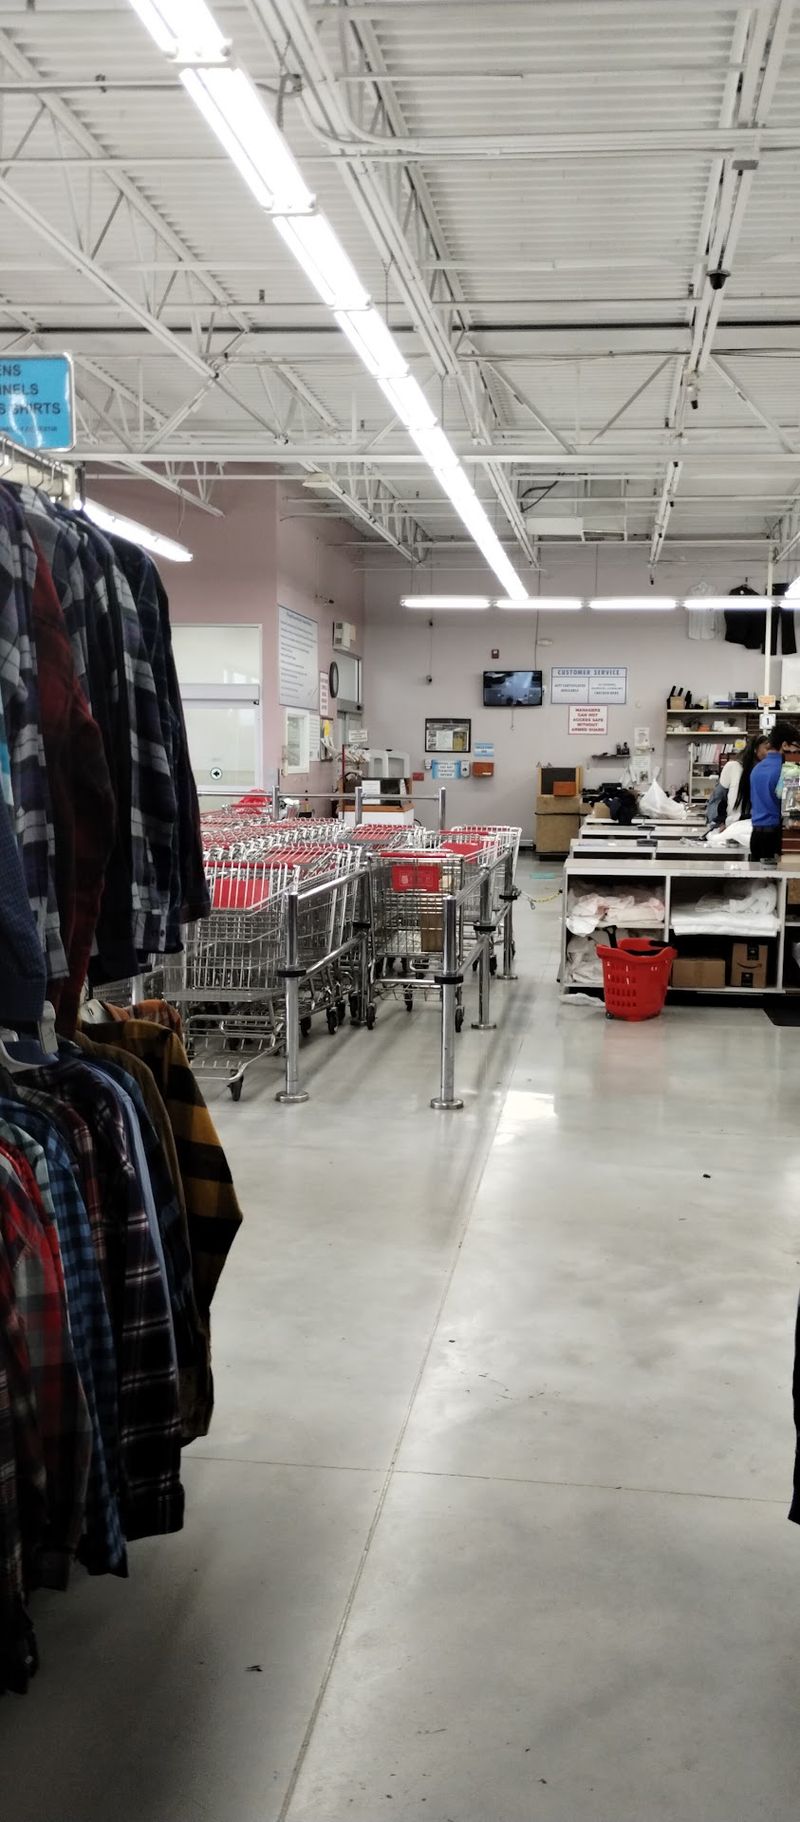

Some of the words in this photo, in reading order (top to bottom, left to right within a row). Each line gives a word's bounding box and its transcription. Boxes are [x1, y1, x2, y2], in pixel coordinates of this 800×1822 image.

[0, 364, 22, 376] NS
[0, 383, 39, 396] NELS
[12, 402, 61, 415] SHIRTS
